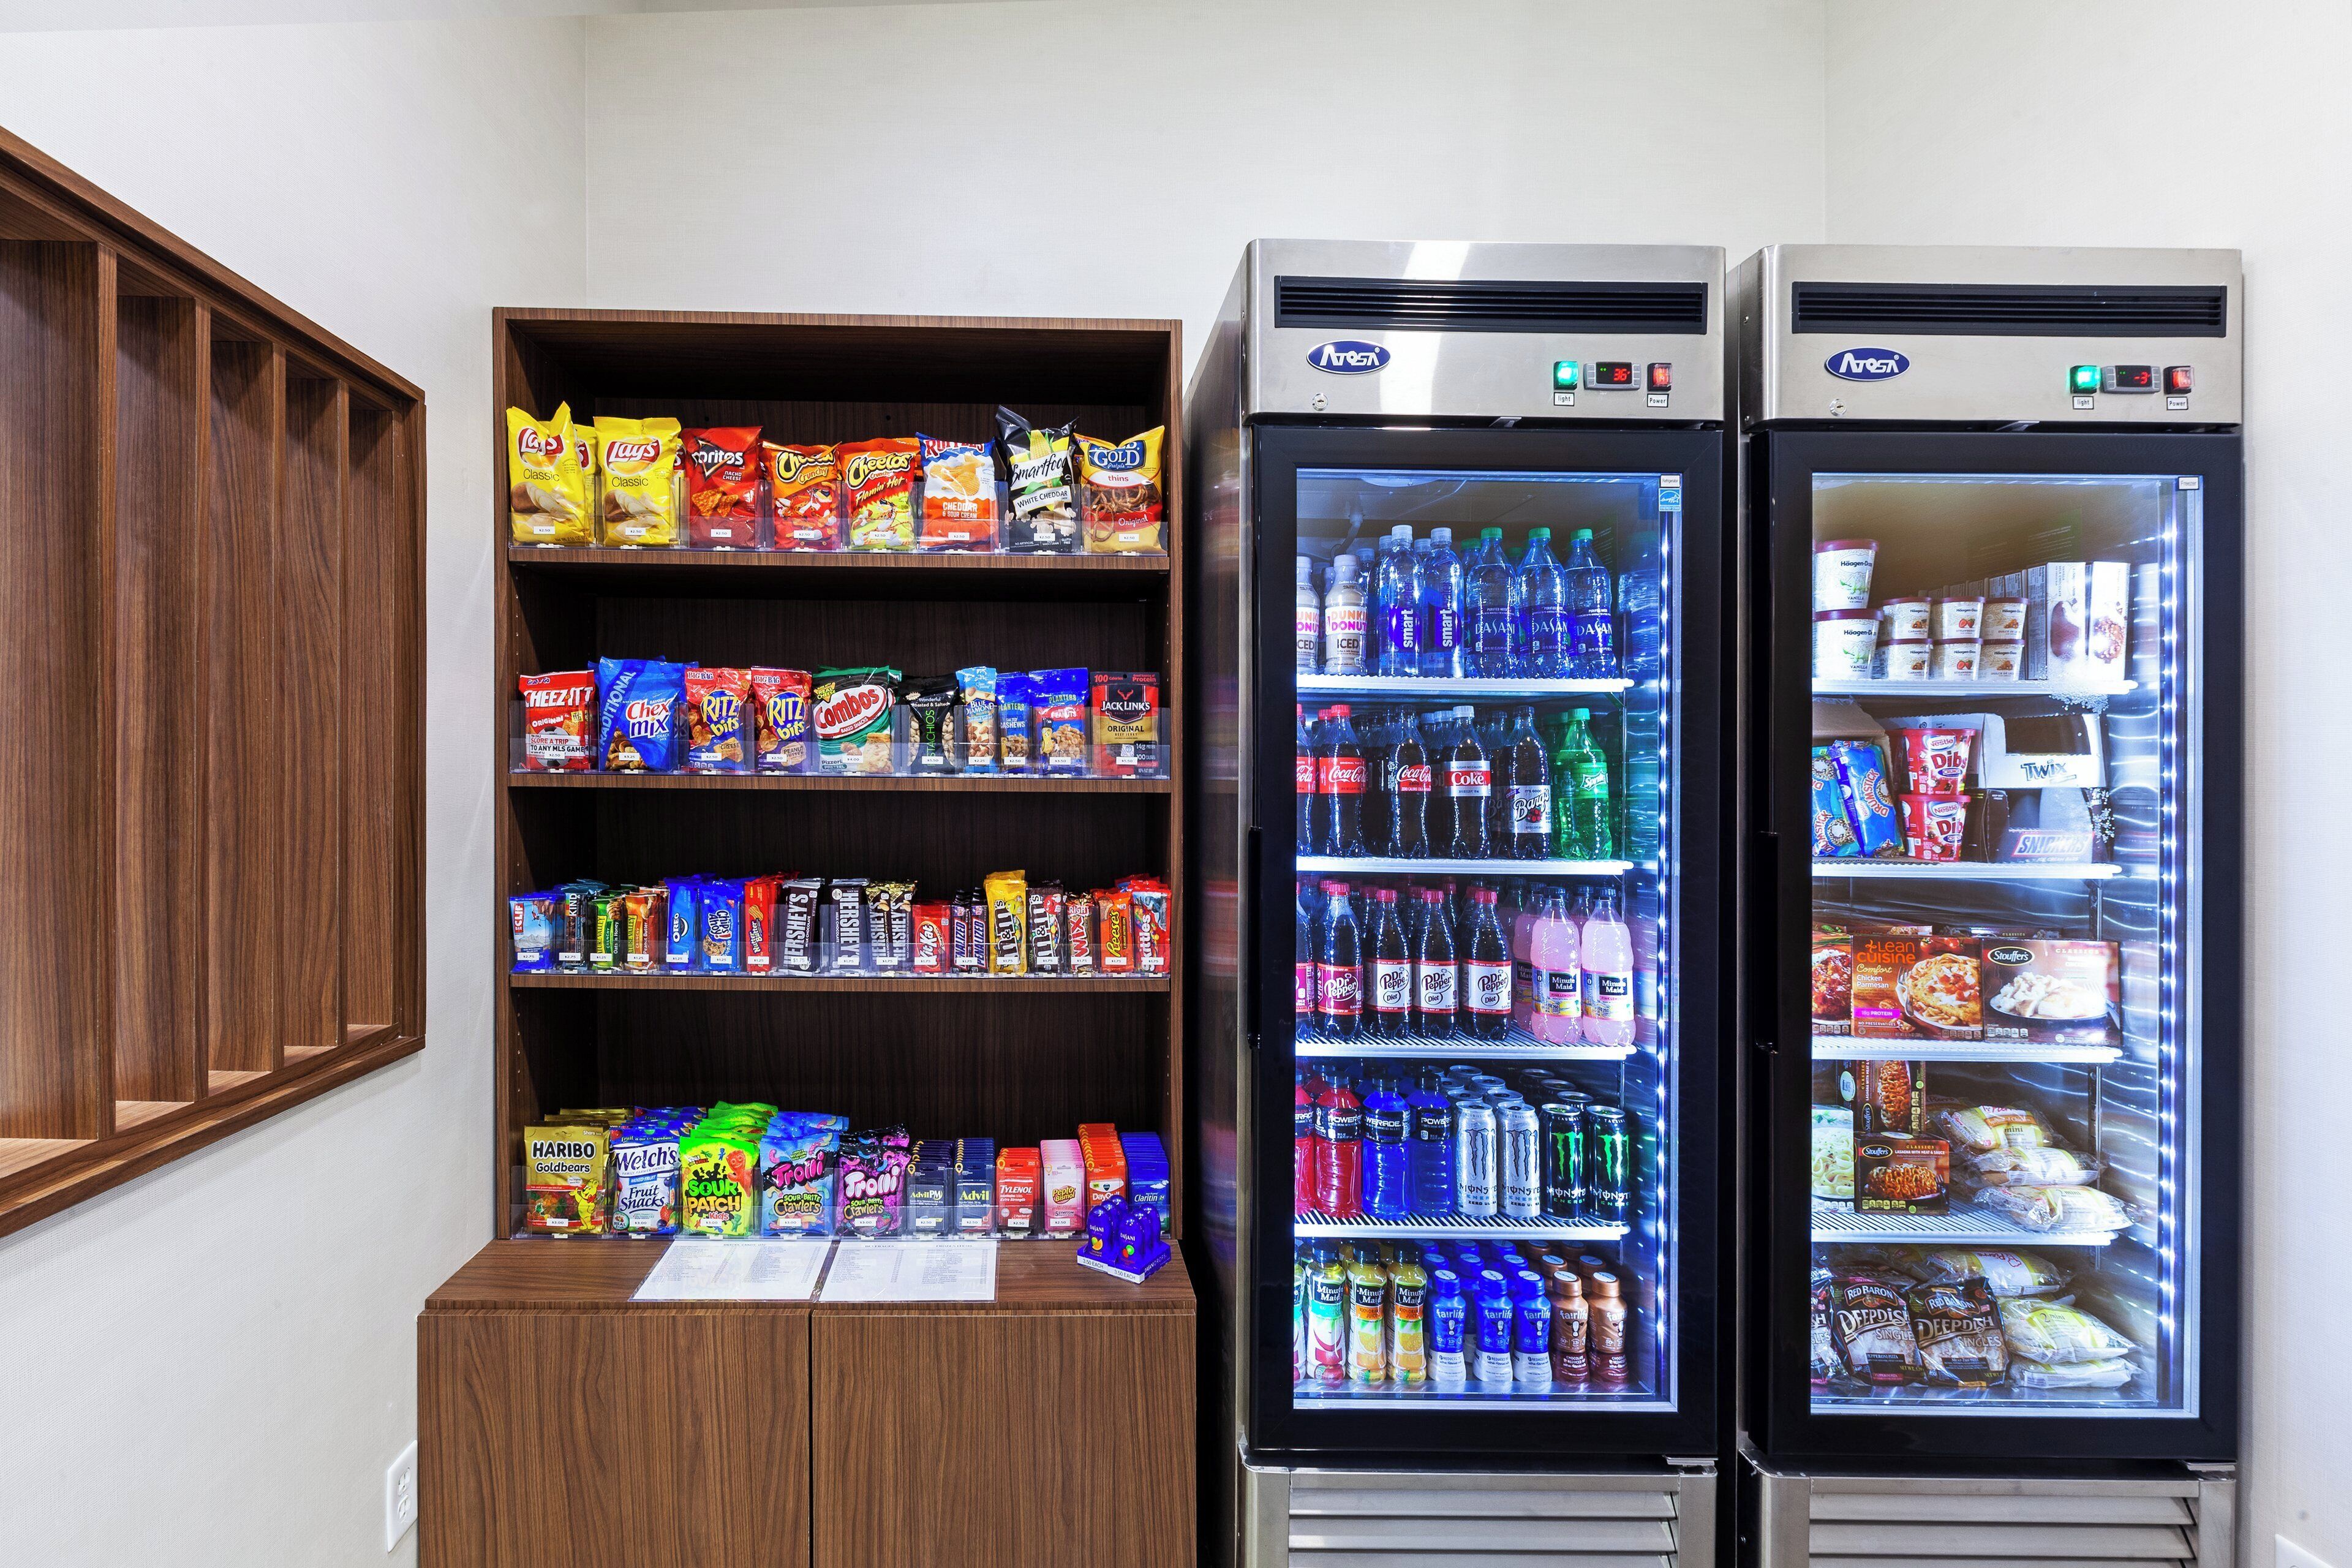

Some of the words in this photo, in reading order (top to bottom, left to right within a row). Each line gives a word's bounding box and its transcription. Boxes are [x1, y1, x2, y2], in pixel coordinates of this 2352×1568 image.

[1839, 353, 1899, 372] ATOSA
[1613, 369, 1627, 381] 36
[1093, 450, 1140, 466] GOLD
[524, 469, 560, 481] Classic
[798, 466, 827, 484] Crunchy
[849, 453, 913, 487] Cheetos
[612, 477, 648, 487] Classic
[856, 483, 884, 505] Flamin'
[887, 477, 904, 489] Hot
[943, 502, 978, 512] CHEDDAR
[1017, 497, 1038, 508] WHITE
[1039, 491, 1068, 500] CHEDDAR
[1118, 516, 1148, 527] Original
[1404, 609, 1414, 647] smart
[1440, 609, 1452, 647] smart
[1476, 618, 1515, 635] DASANI
[1337, 639, 1359, 648] ICED
[1049, 695, 1076, 703] PLANTERS
[1101, 701, 1124, 711] JACK
[1125, 701, 1150, 710] LINK'S
[627, 700, 671, 720] Chex
[704, 696, 739, 722] RITZ
[769, 698, 804, 726] RITZ
[815, 688, 879, 728] Combos
[631, 715, 668, 736] mix
[710, 717, 739, 736] bits
[777, 720, 805, 740] bits
[841, 723, 853, 733] BAKED
[854, 717, 869, 728] SNACKS
[1931, 752, 1967, 769] Dibs
[1452, 772, 1483, 785] Coke
[1863, 769, 1890, 817] DRUMSTICK
[1513, 789, 1550, 821] Barq's
[2018, 836, 2087, 853] SNICKERS
[1994, 951, 2029, 962] Stouffer's
[1856, 963, 1893, 973] Comfort
[1336, 978, 1349, 987] Dr
[1423, 976, 1451, 991] Pepper
[1433, 973, 1444, 982] Dr
[1479, 976, 1507, 992] Pepper
[1490, 973, 1502, 984] Dr
[1325, 981, 1356, 998] Pepper
[532, 1142, 595, 1158] HARIBO
[616, 1147, 677, 1171] Welch's
[536, 1163, 590, 1174] Goldbears
[772, 1151, 824, 1187] Trolli
[688, 1179, 738, 1196] SOUR
[844, 1166, 900, 1197] Trolli
[628, 1185, 660, 1199] Fruit
[959, 1191, 989, 1200] Advil
[1055, 1192, 1076, 1203] Bismol
[620, 1196, 665, 1211] Snacks
[688, 1197, 741, 1212] PATCH
[775, 1200, 821, 1216] Crawlers
[709, 1212, 729, 1220] Kids
[844, 1204, 884, 1219] Crawlers
[1120, 1232, 1135, 1241] DASANI
[1124, 1272, 1136, 1280] EACH
[1320, 1293, 1341, 1302] Maid
[1363, 1294, 1382, 1303] Maid
[1403, 1294, 1421, 1303] Maid
[1847, 1287, 1861, 1299] RED
[1862, 1285, 1893, 1299] BARON
[1958, 1336, 2002, 1346] SINGLES
